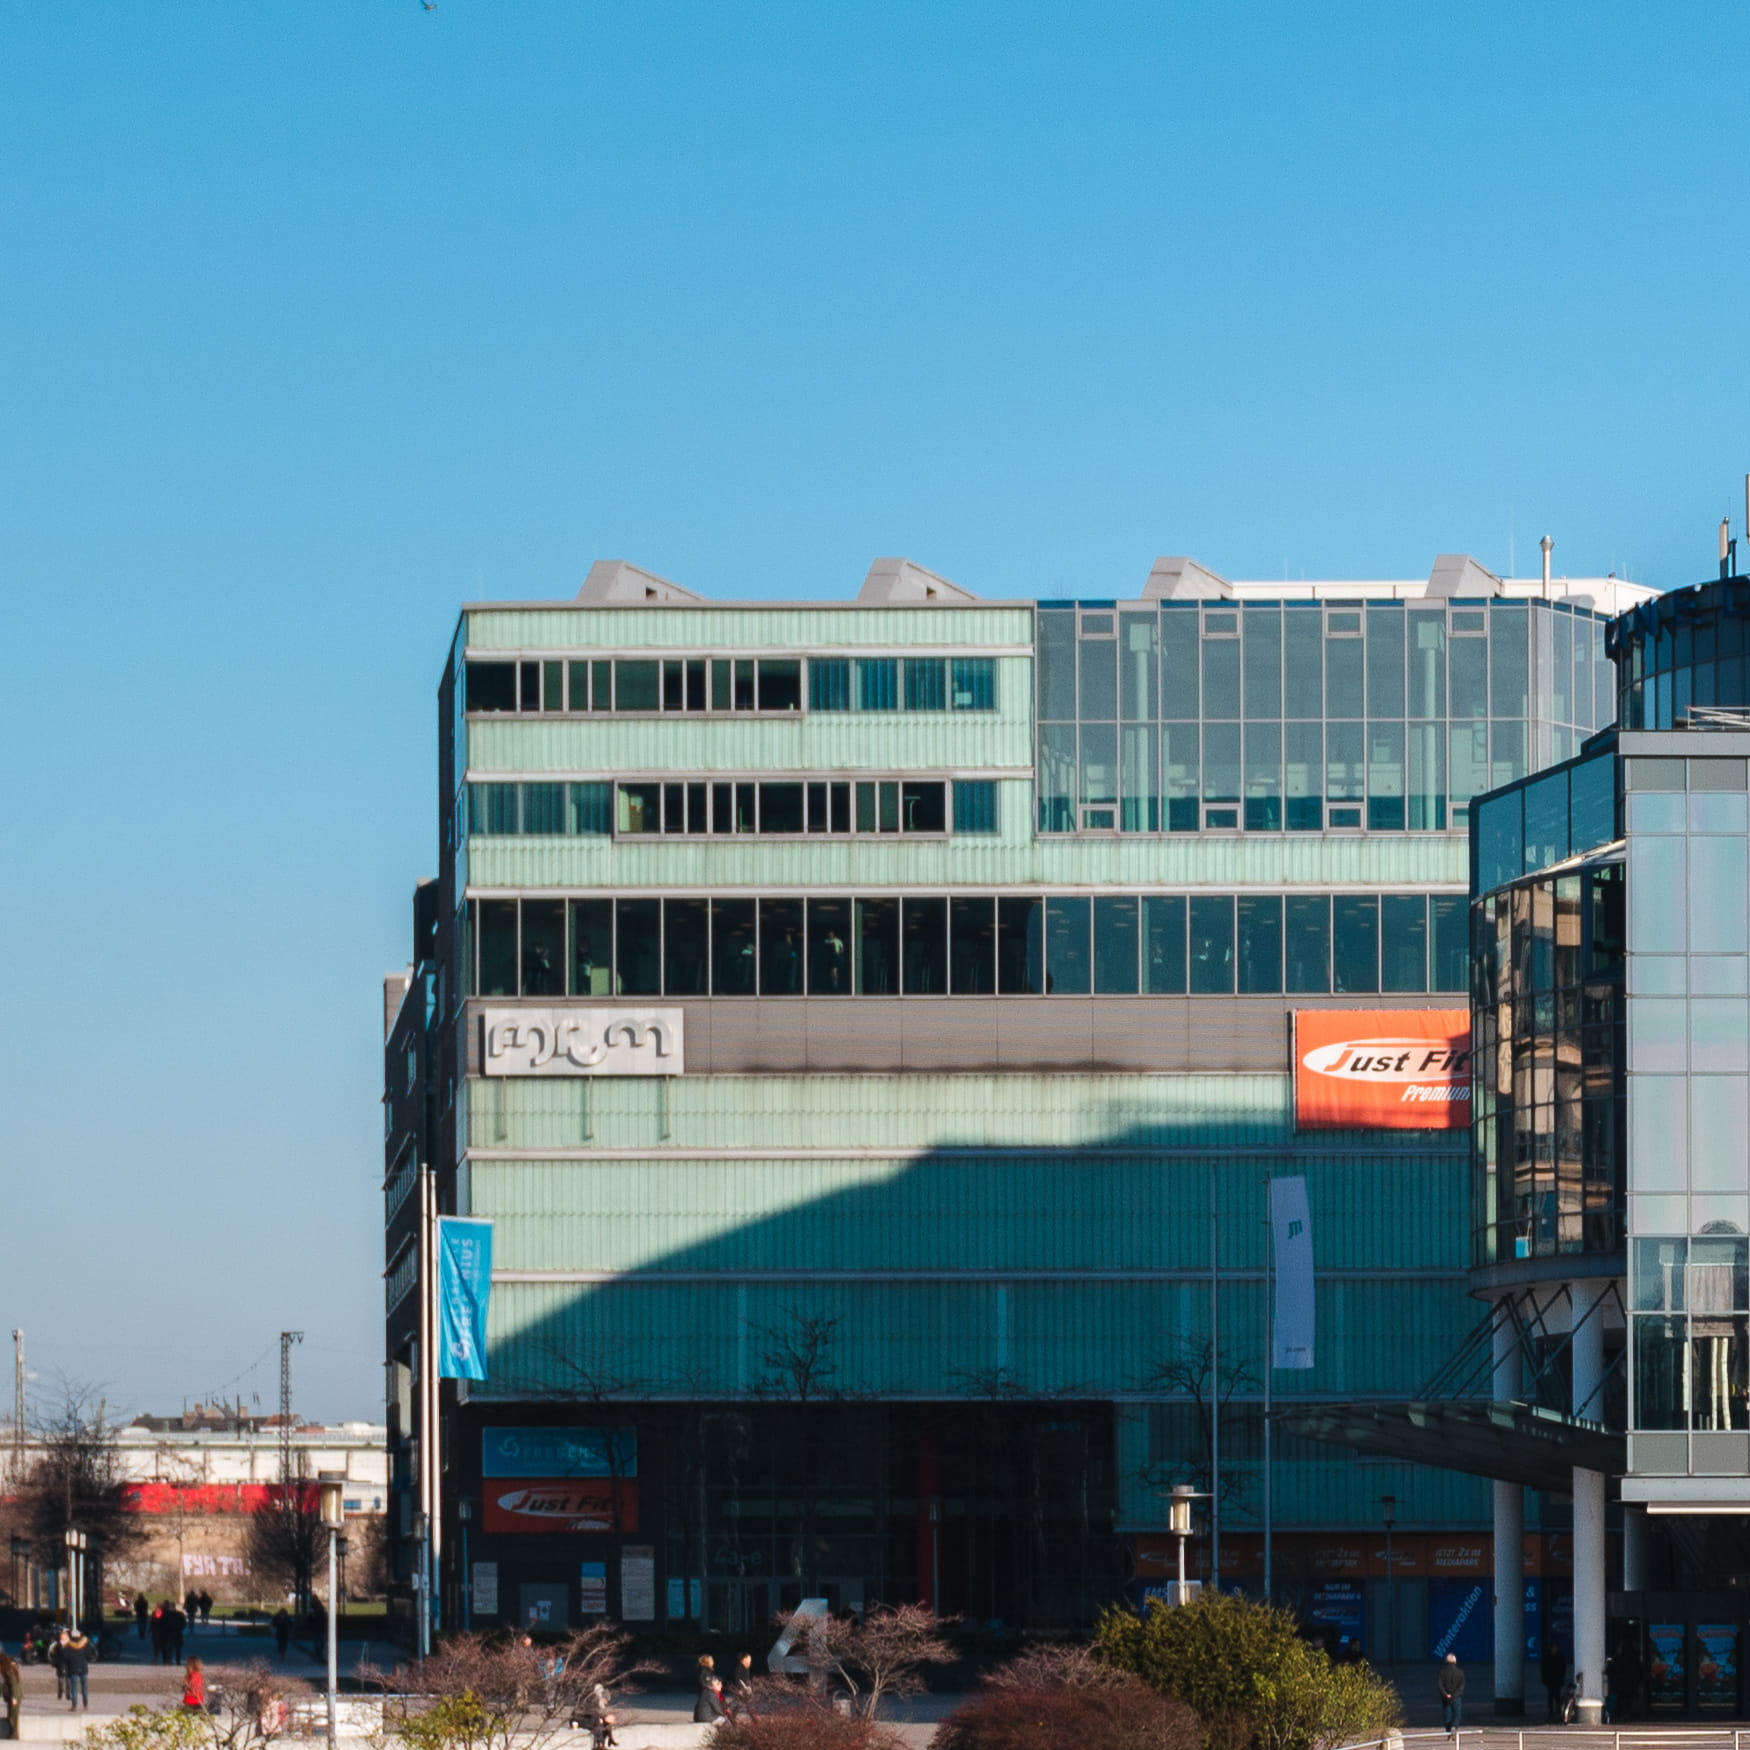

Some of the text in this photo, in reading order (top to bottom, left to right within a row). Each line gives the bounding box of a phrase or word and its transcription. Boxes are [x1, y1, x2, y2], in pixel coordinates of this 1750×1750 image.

[1323, 1045, 1470, 1073] Just Fit
[1401, 1083, 1470, 1102] Premium
[510, 1491, 571, 1511] Just
[1432, 1584, 1484, 1659] Winteraktion
